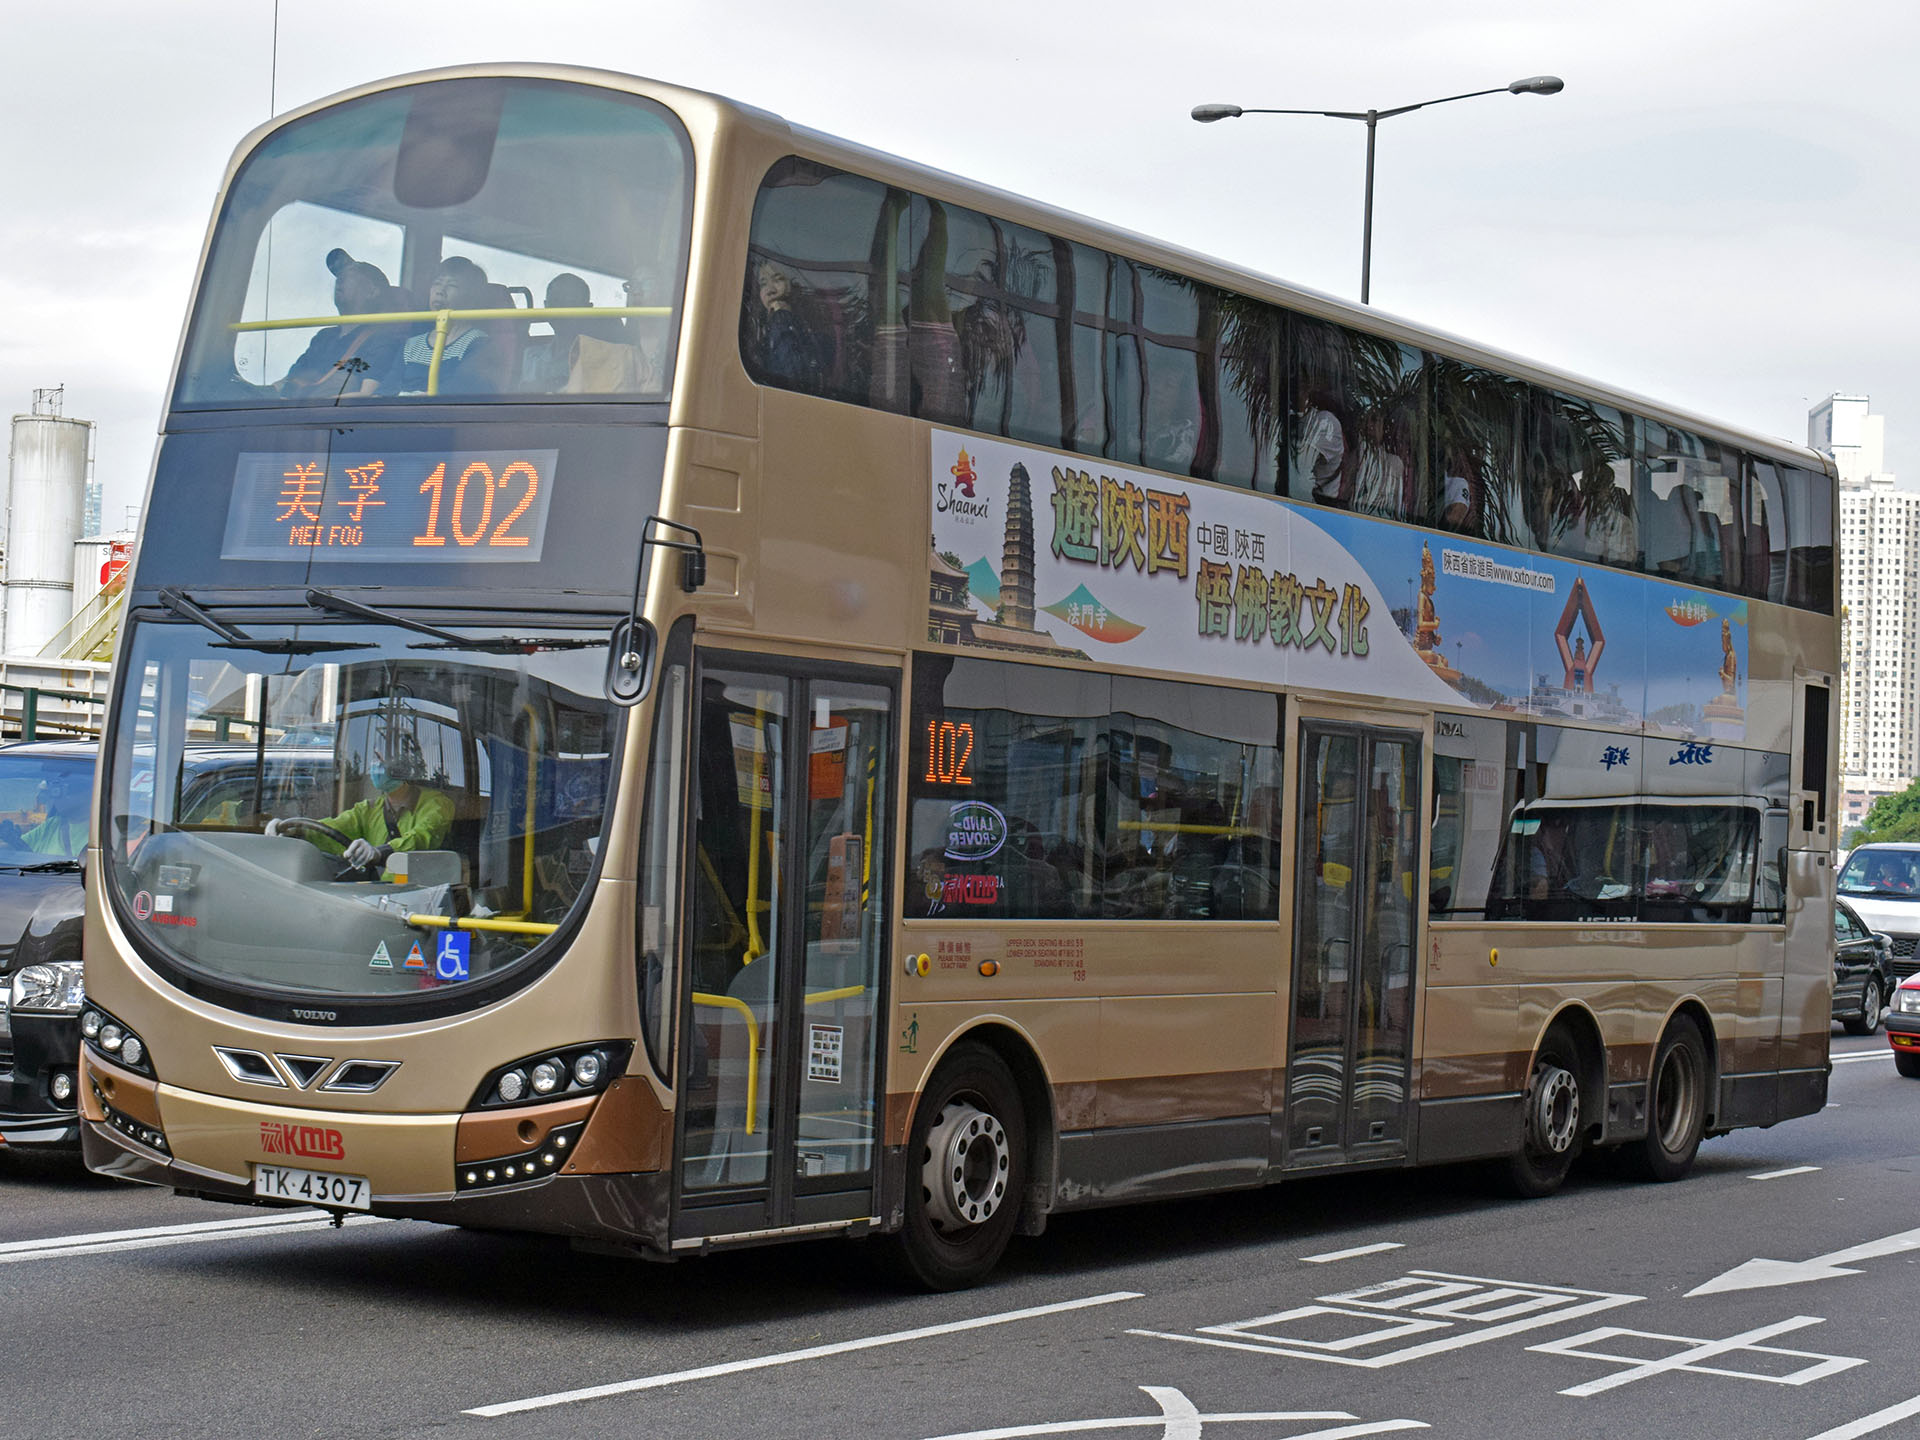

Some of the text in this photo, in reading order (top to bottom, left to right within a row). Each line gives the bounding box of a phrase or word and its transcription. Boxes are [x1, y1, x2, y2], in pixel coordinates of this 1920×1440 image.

[276, 461, 386, 522] 美孚
[413, 462, 539, 546] 102
[937, 483, 990, 519] Shaanxi
[289, 526, 363, 546] MEI FOO
[1051, 465, 1191, 579] 遊陝西
[1066, 602, 1108, 630] 法門寺
[1195, 557, 1370, 656] 悟佛教文化
[926, 720, 974, 784] 102
[1073, 970, 1086, 982] 138
[292, 1009, 337, 1022] VOLVO
[282, 1123, 346, 1160] KMB
[261, 1168, 364, 1205] TK 4307
